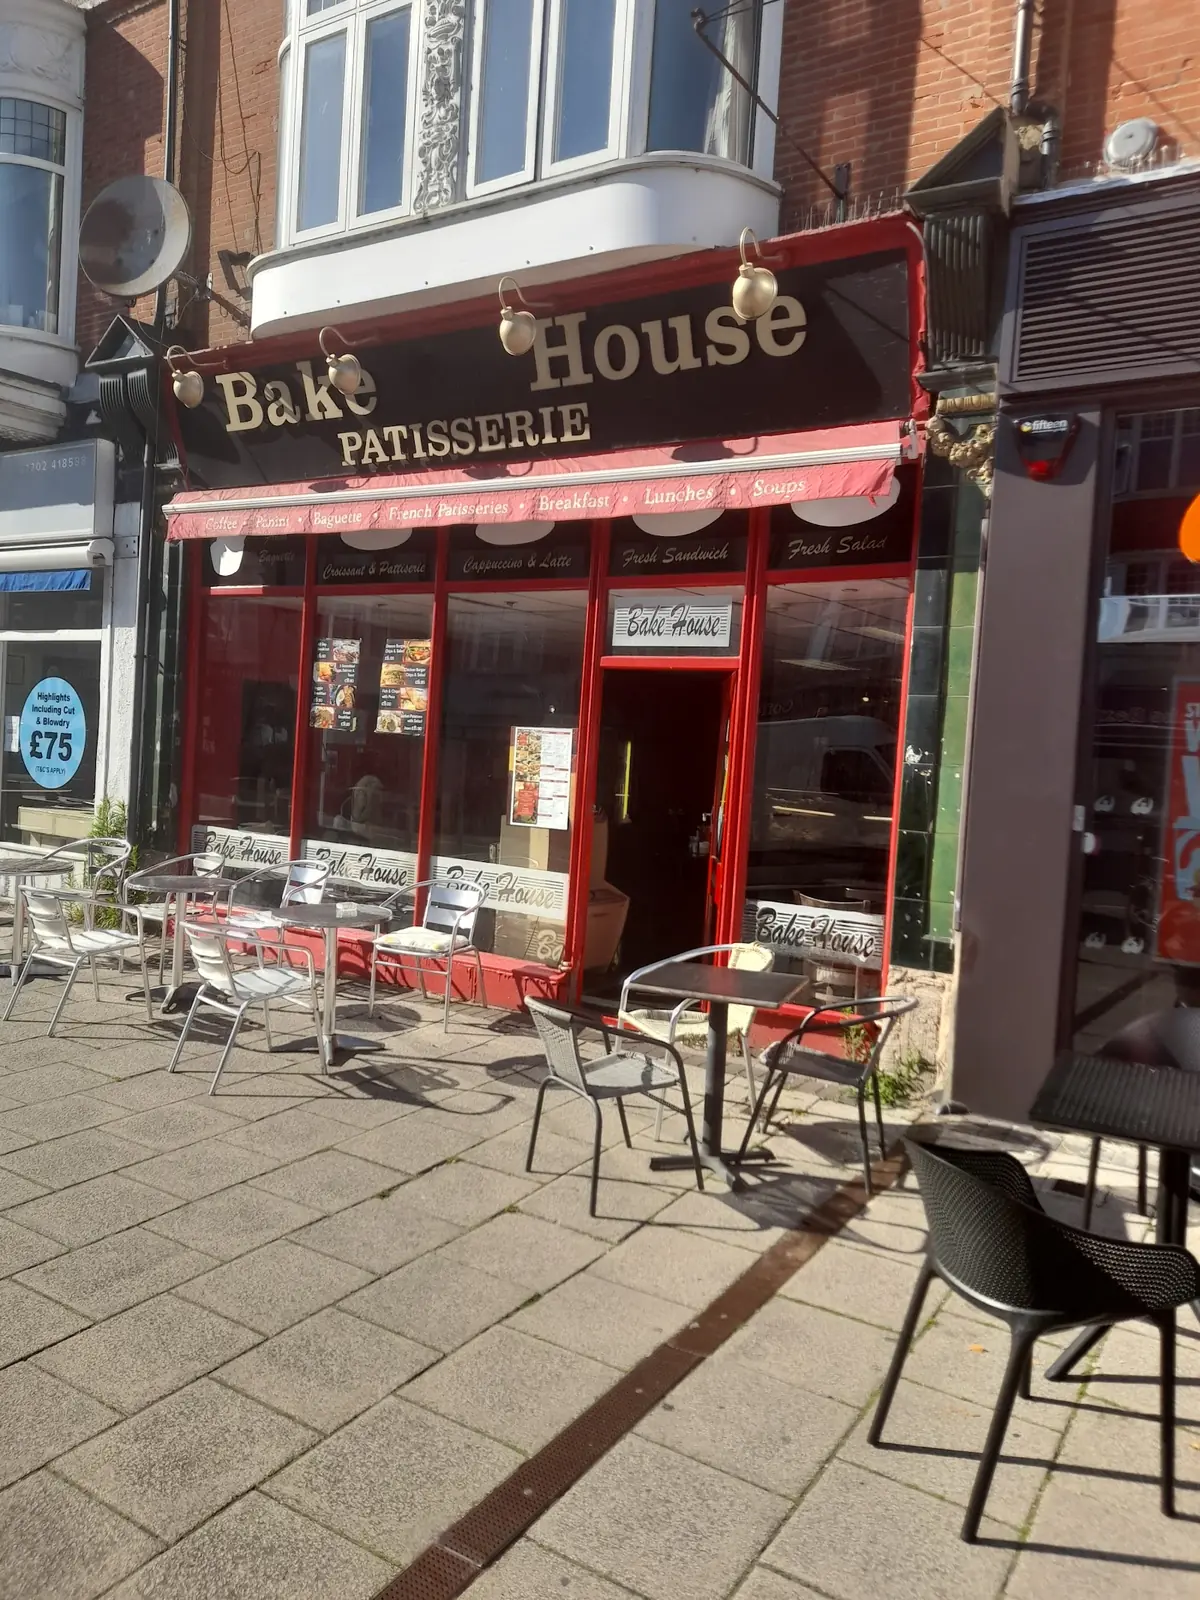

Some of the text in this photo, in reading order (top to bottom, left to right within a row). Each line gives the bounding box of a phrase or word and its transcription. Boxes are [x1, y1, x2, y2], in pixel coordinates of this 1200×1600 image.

[215, 295, 808, 433] Bake House
[337, 401, 591, 467] PATISSERIE
[205, 478, 806, 531] Coffee Panini Baguette French Patisseries Breakfast Lunches Soups
[463, 551, 572, 574] Cappuccino & Latte
[622, 541, 730, 568] Fresh Sandwich
[787, 533, 888, 560] Fresh Salad
[322, 563, 366, 580] Croissant
[368, 561, 377, 575] &
[627, 602, 721, 637] Bake House
[32, 704, 75, 716] Including Cut
[37, 691, 71, 703] Highlights
[36, 717, 70, 729] & Blowdry
[29, 730, 73, 762] £75
[50, 765, 66, 776] APPLY)
[204, 830, 282, 865] Bake House
[358, 852, 408, 887] House
[496, 871, 555, 909] House
[756, 906, 875, 958] Bake House
